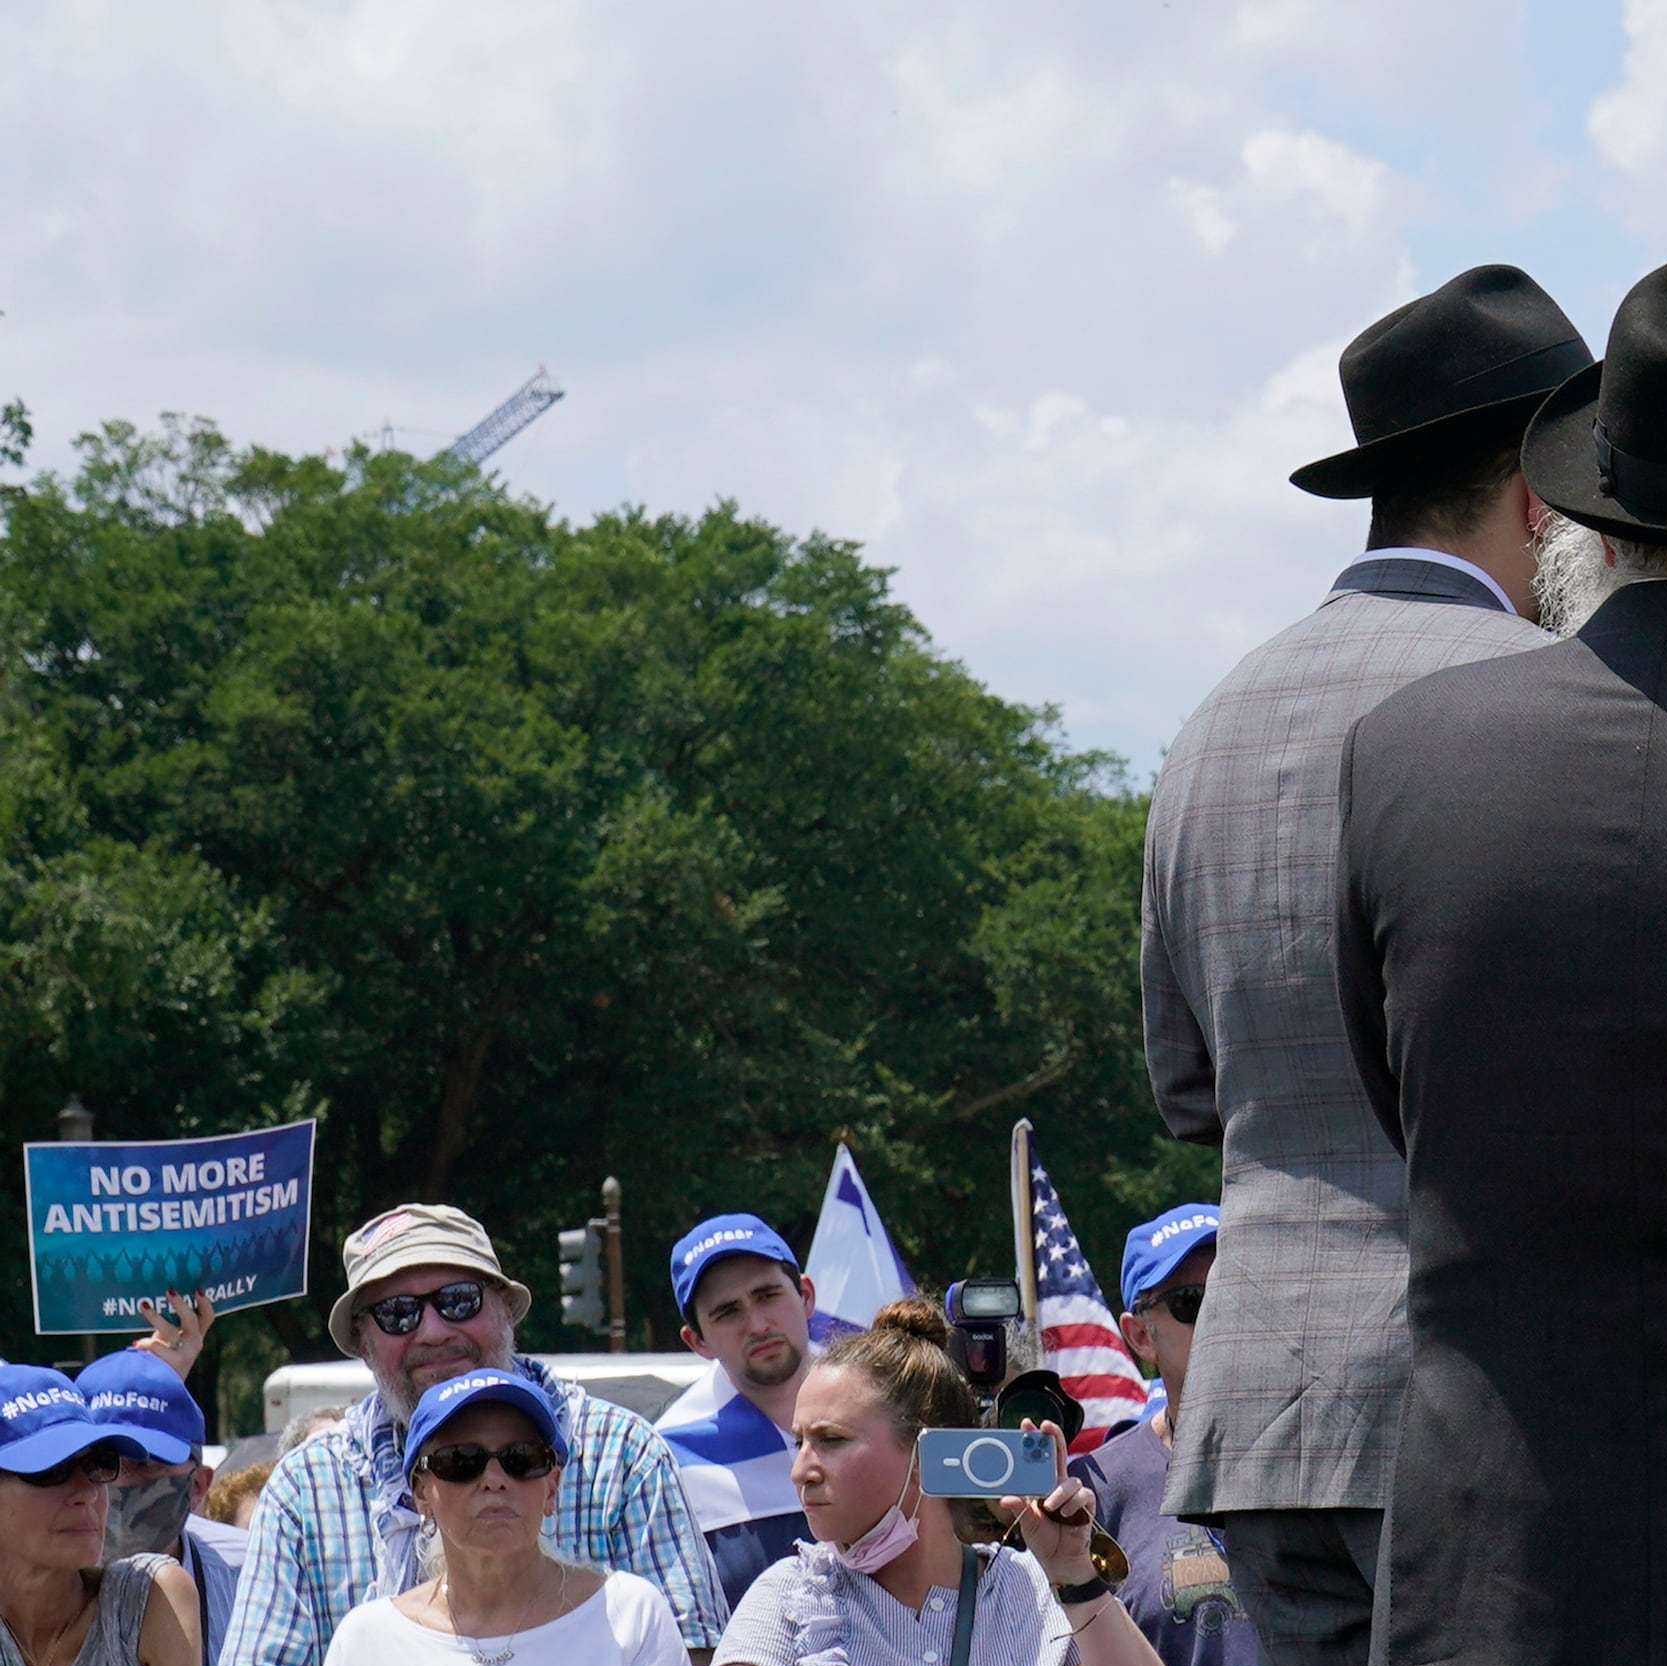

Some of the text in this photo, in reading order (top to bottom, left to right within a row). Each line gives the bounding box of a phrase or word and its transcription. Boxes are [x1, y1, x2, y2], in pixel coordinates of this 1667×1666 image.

[90, 1152, 265, 1196] NO MORE
[43, 1178, 299, 1234] ANTISEMITISM
[684, 1229, 753, 1265] #NoFear
[91, 1391, 168, 1414] #NoFear
